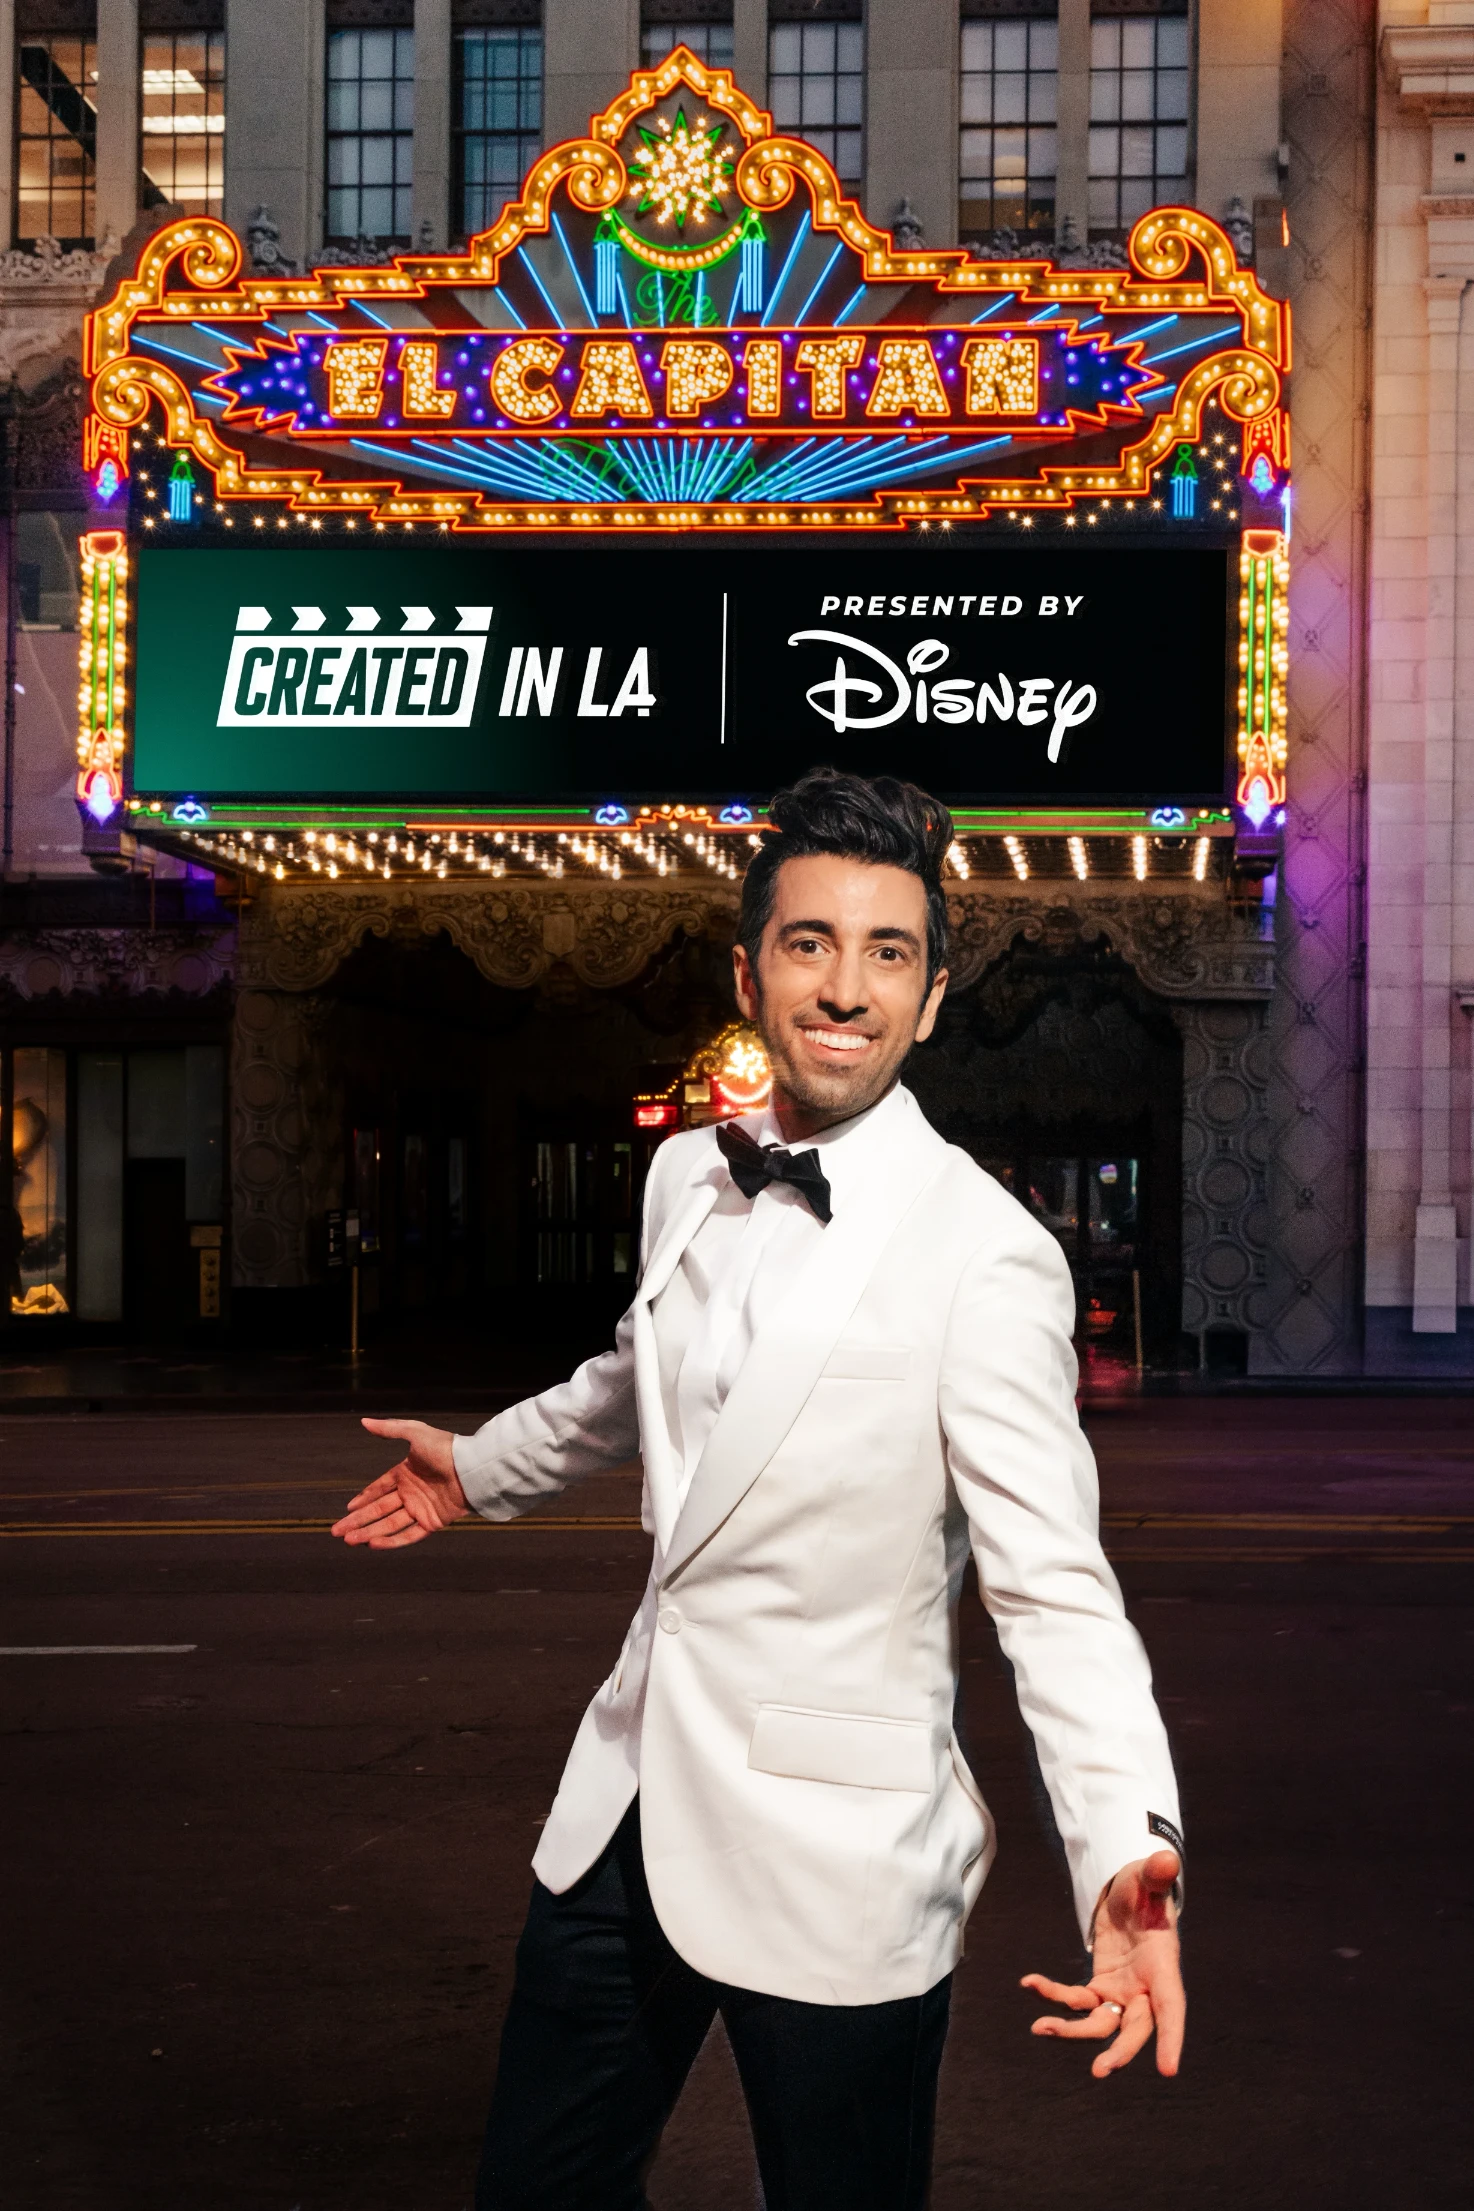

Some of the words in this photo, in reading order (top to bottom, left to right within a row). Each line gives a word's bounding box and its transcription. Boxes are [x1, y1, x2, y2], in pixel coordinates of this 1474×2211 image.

[633, 271, 719, 326] The
[323, 339, 456, 419] EL
[491, 336, 1039, 423] CAPITAN
[539, 437, 802, 498] Theatre
[821, 596, 1023, 616] PRESENTED
[1039, 596, 1084, 616] BY
[236, 647, 468, 716] CREATED
[499, 647, 563, 717] IN
[577, 647, 656, 717] LA
[788, 630, 1097, 764] Disney
